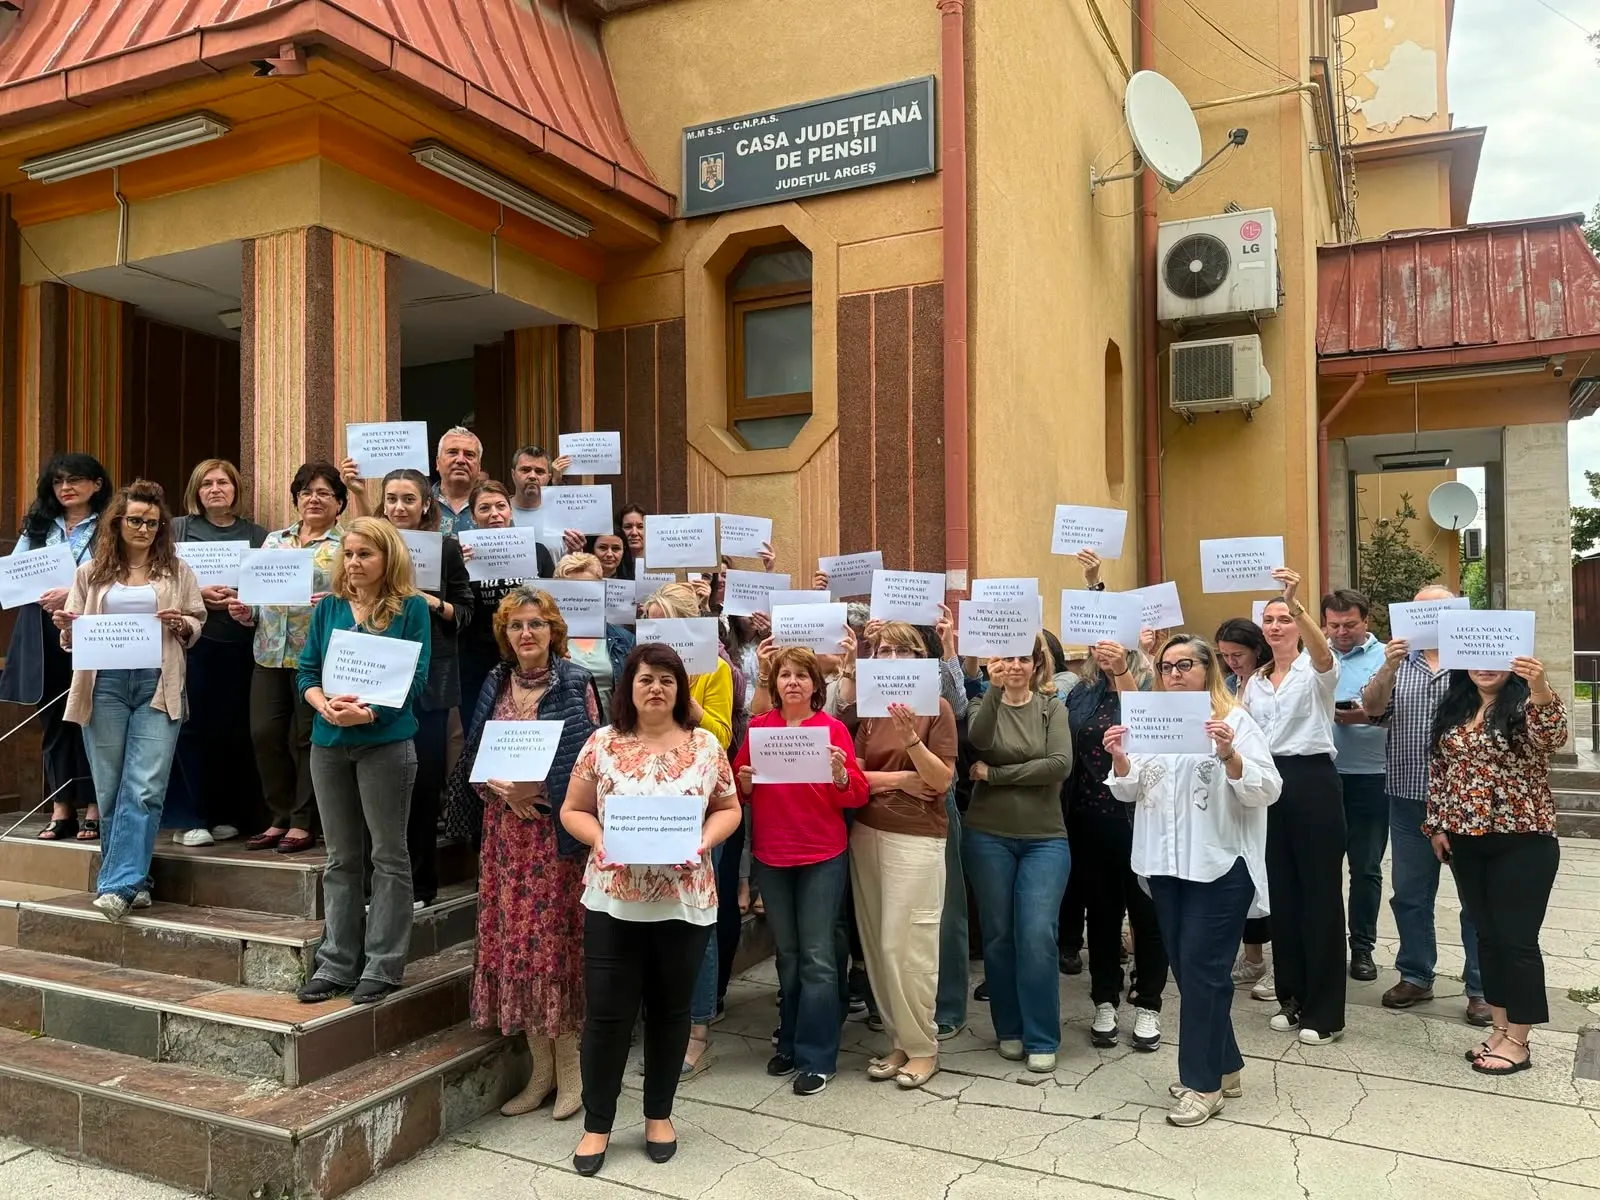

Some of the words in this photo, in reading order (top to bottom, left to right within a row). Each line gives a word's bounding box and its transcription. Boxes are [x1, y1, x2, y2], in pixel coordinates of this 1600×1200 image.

[733, 115, 779, 131] C.N.P.A.S.
[736, 130, 790, 156] CASA
[776, 151, 802, 170] DE
[809, 136, 877, 165] PENSII
[1243, 244, 1260, 254] LG
[610, 814, 636, 822] Respect
